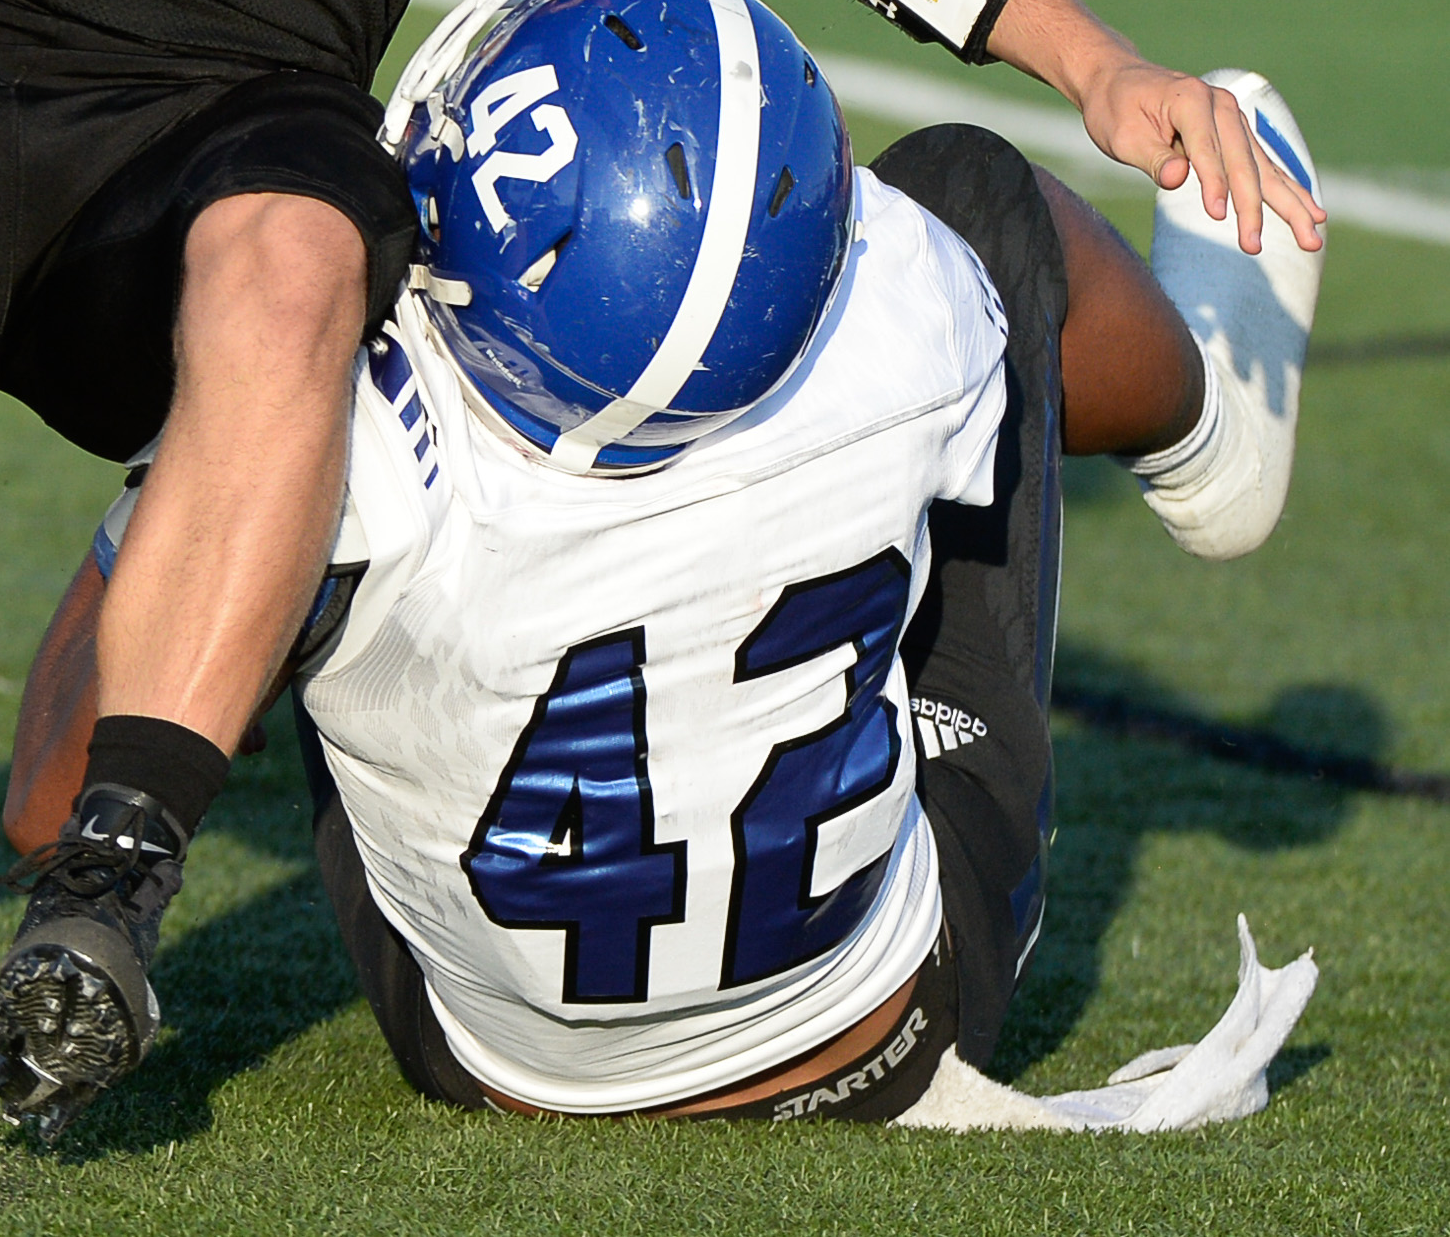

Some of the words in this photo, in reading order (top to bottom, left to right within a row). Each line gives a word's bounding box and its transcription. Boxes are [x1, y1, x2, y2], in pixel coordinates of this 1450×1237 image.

[466, 64, 579, 234] 42
[459, 544, 912, 1005] 42
[909, 697, 988, 738] adidas
[772, 1006, 929, 1122] STARTER
